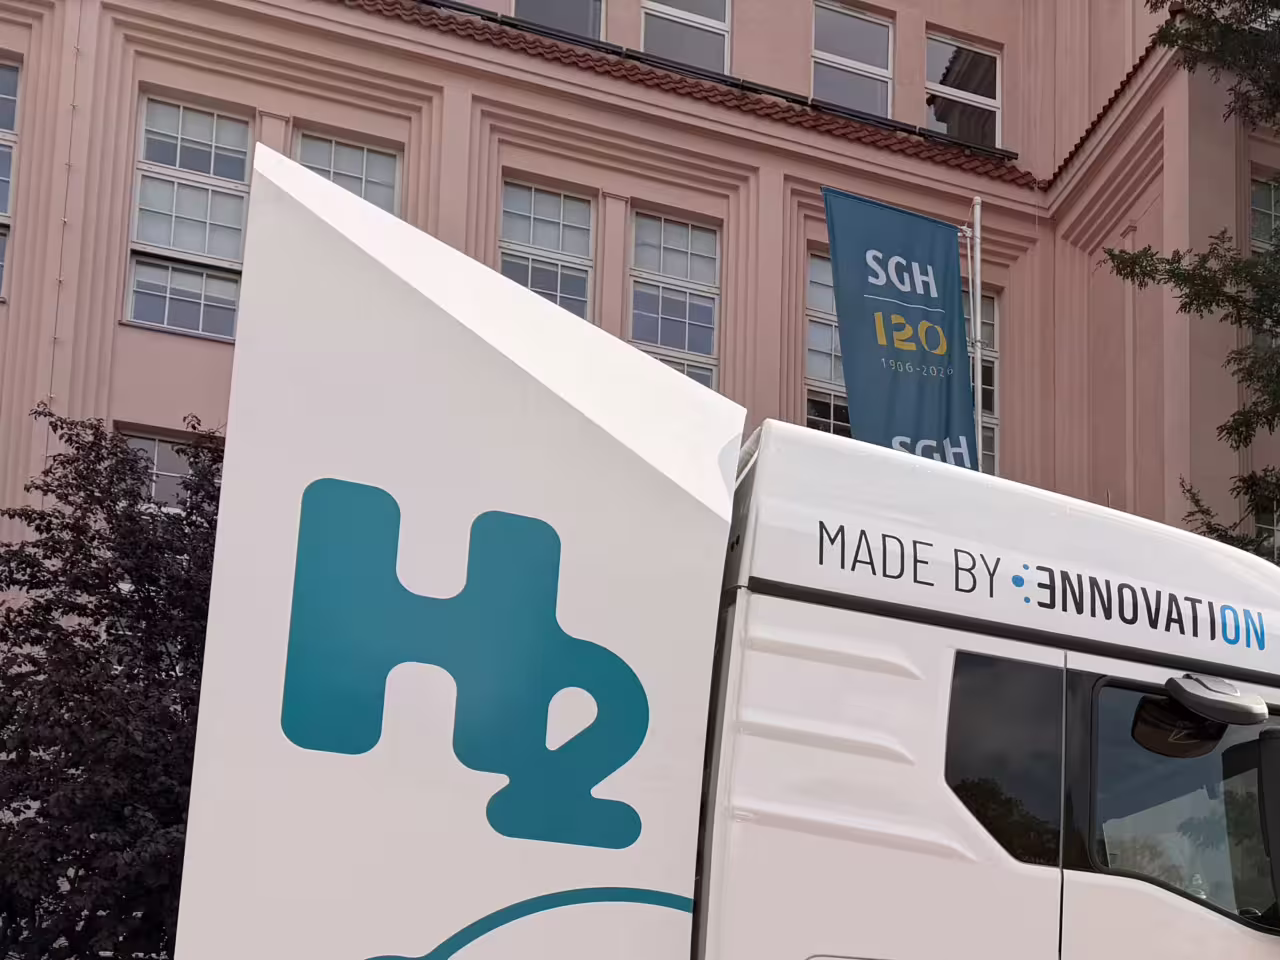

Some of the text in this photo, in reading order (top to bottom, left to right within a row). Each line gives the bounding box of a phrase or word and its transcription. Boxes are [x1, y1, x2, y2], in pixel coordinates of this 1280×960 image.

[865, 249, 938, 298] SGH
[874, 311, 947, 356] 120
[880, 357, 954, 378] 1906-2026
[818, 520, 935, 588] MADE
[953, 548, 1001, 599] BY
[281, 477, 650, 850] H2
